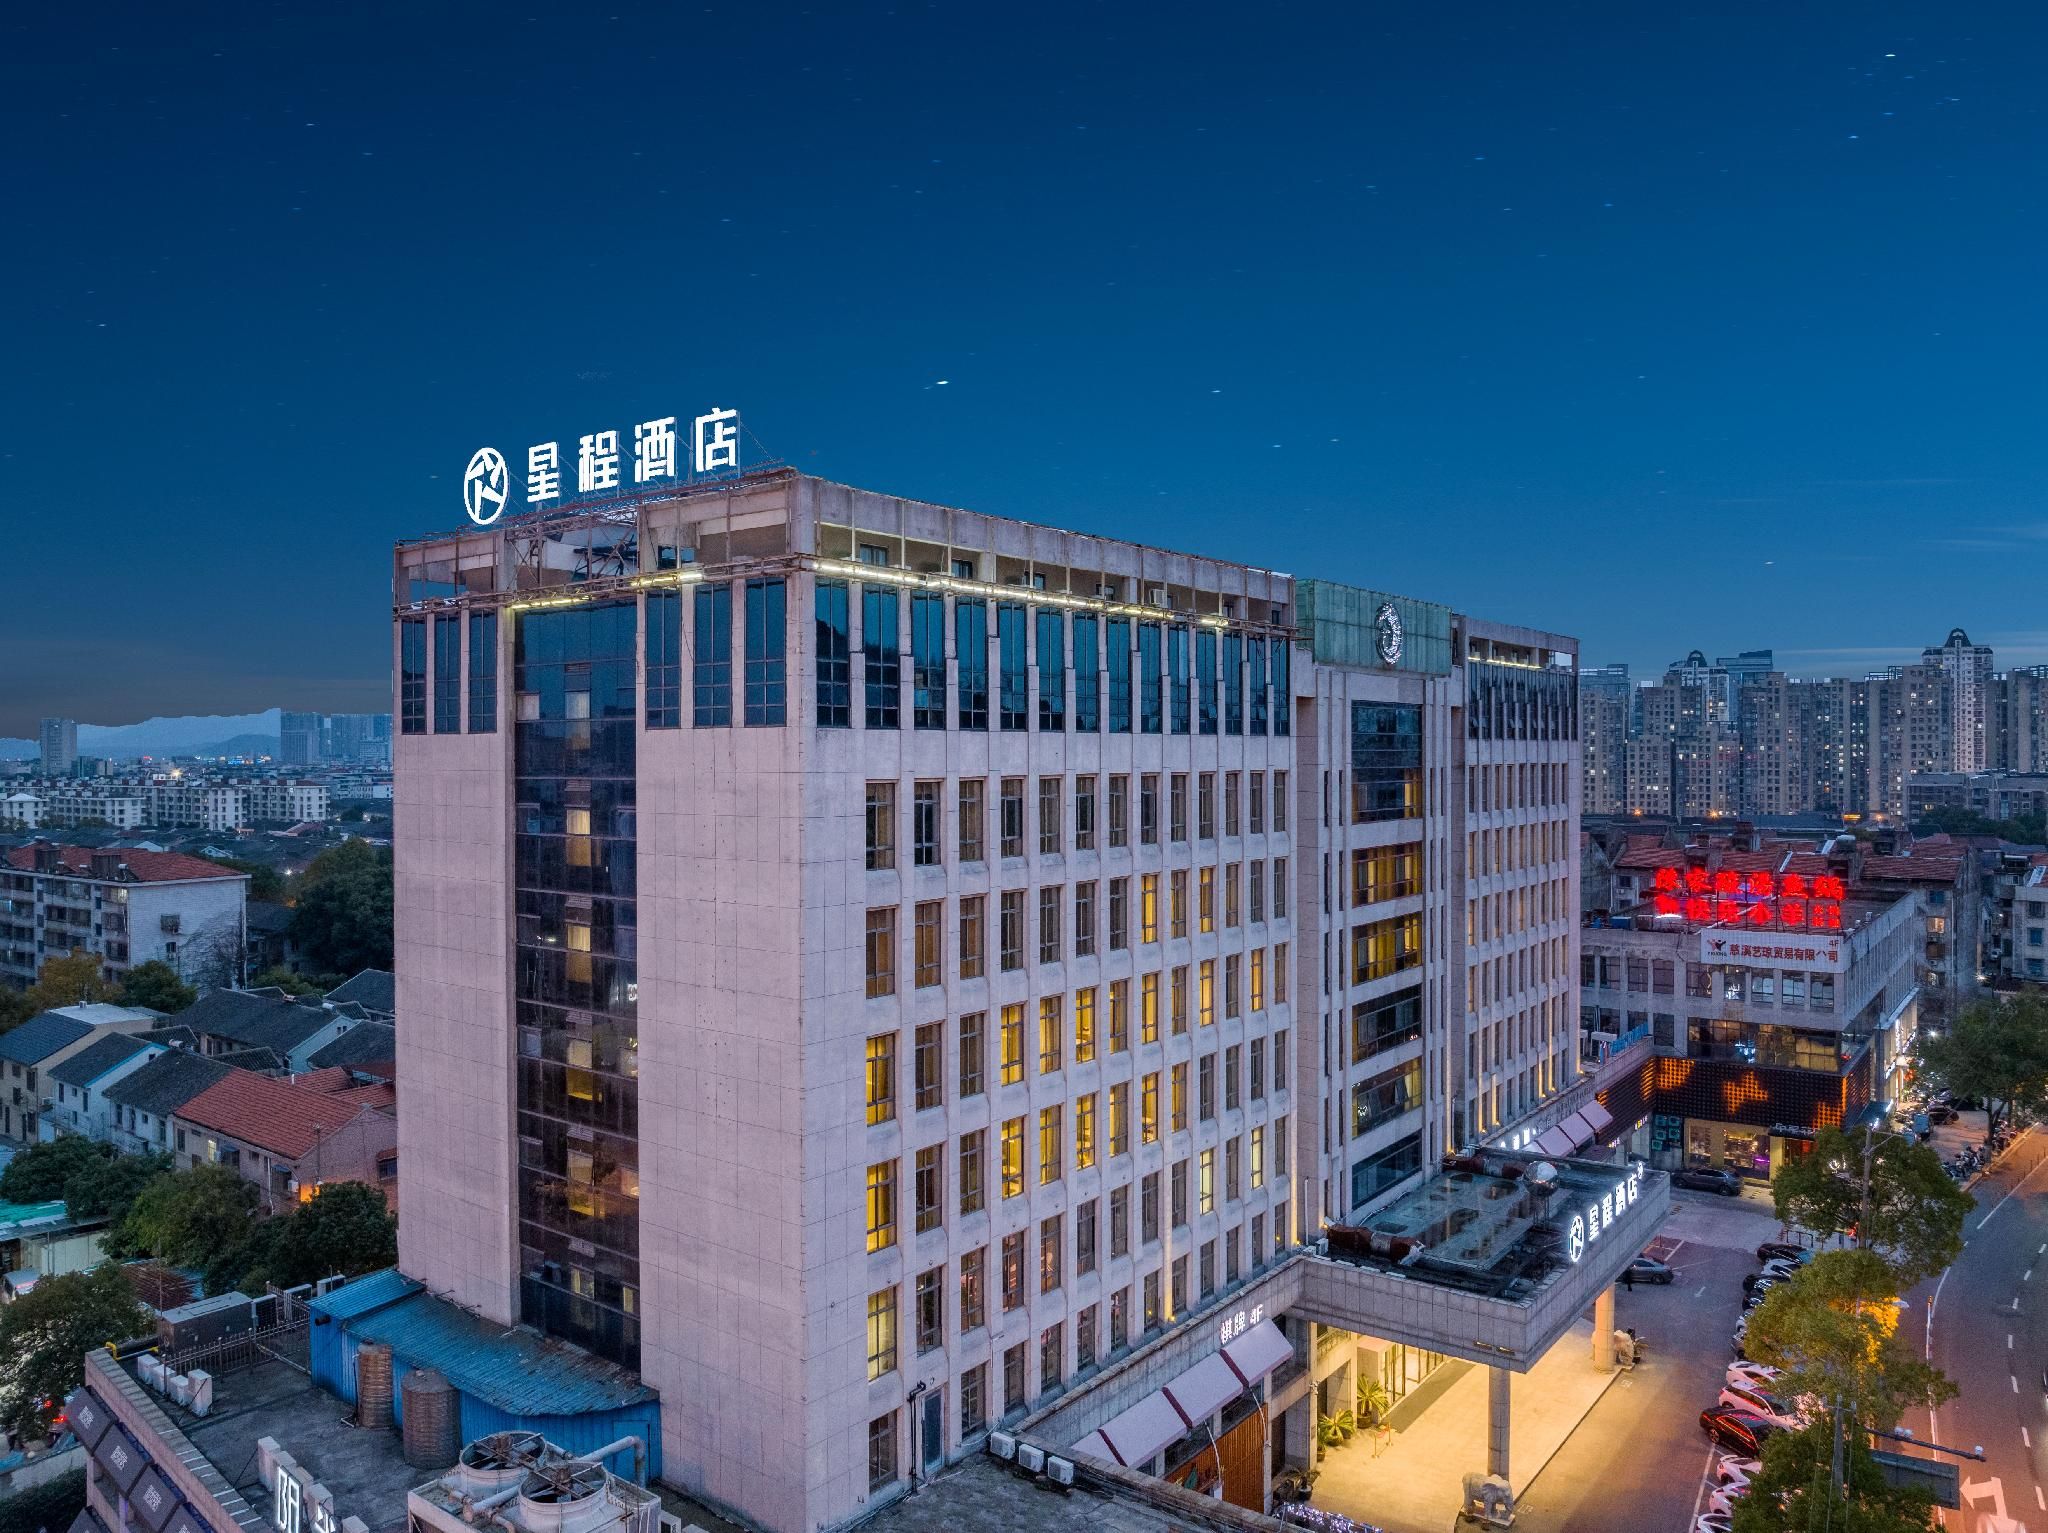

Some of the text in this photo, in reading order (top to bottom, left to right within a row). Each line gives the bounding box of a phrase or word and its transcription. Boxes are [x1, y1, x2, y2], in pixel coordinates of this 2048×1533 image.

[527, 407, 737, 502] 星程酒店
[1588, 1173, 1638, 1242] 星程酒店
[1220, 1304, 1264, 1345] 棋牌 4F
